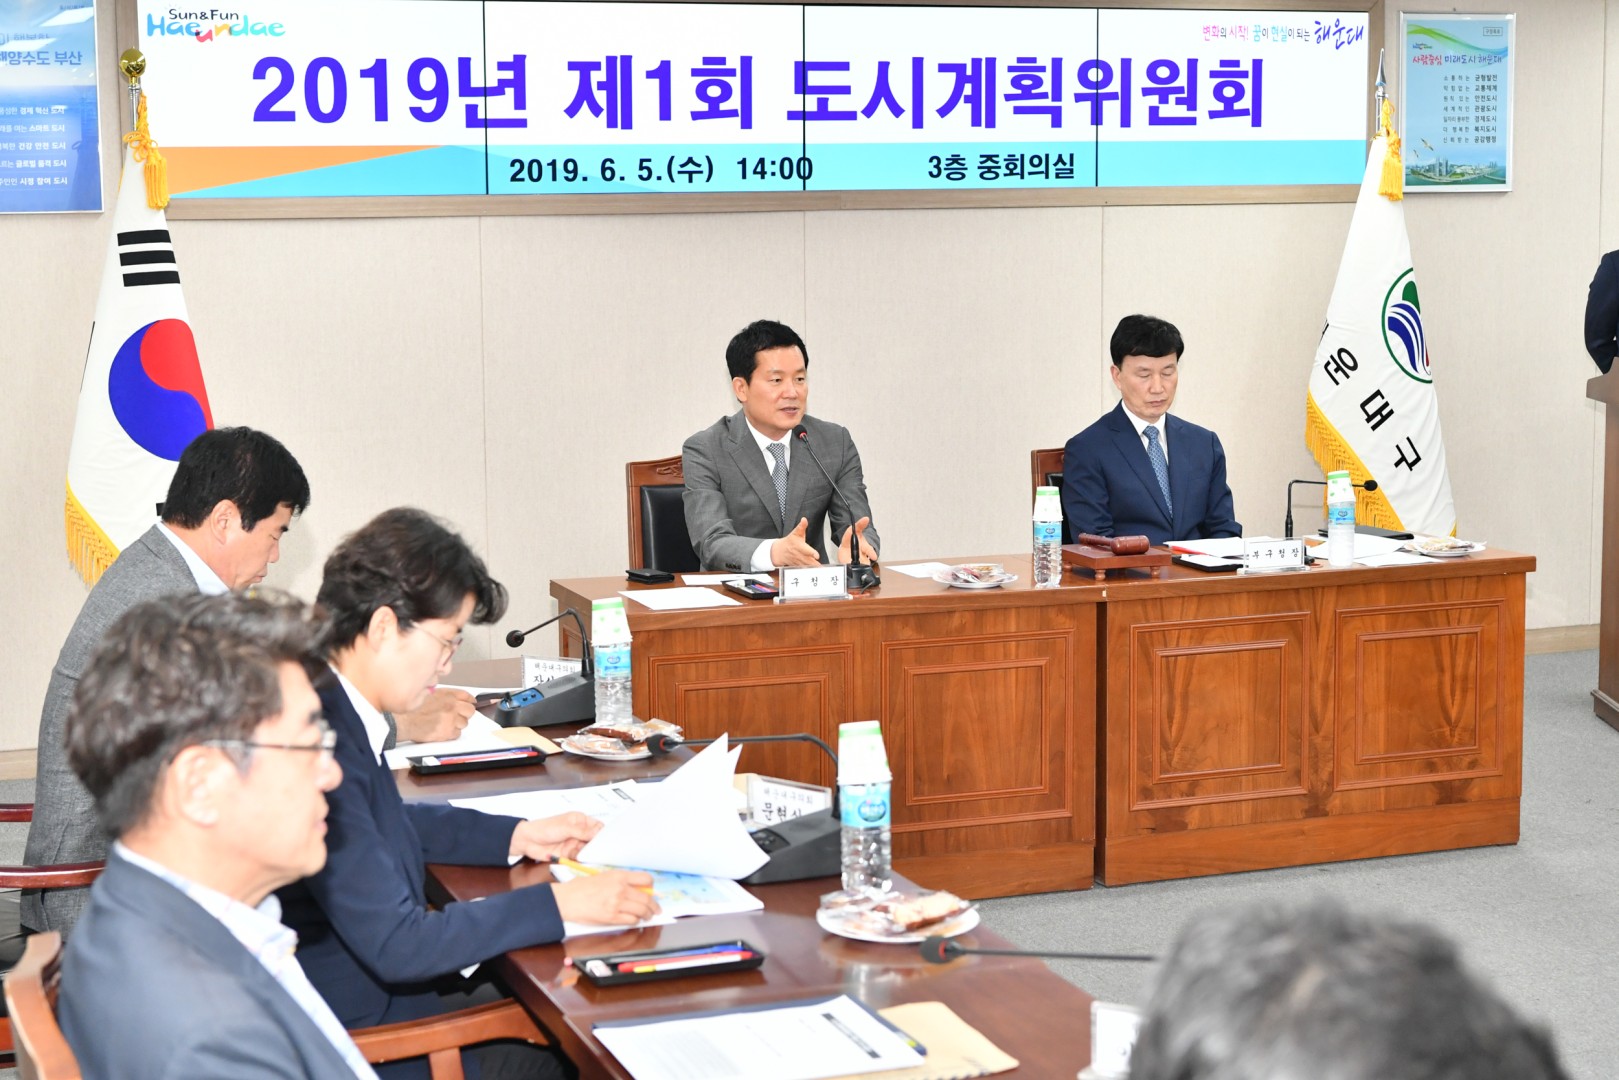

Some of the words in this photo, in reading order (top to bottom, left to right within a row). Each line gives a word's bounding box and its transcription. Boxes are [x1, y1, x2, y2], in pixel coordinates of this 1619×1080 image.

[169, 9, 239, 20] Sun&Fun
[147, 13, 286, 43] Haeundae
[1202, 24, 1227, 41] 변화의
[1229, 25, 1249, 40] 시작!
[1253, 24, 1269, 42] 꿈이
[1271, 25, 1295, 42] 현실이
[1296, 28, 1311, 42] 되는
[1314, 18, 1364, 50] 해운대
[54, 51, 83, 65] 부산
[1412, 54, 1442, 65] 사람중심
[1444, 54, 1476, 64] 미래도시
[1478, 54, 1502, 65] 해운대
[252, 54, 528, 129] 2019년
[563, 54, 753, 130] 제1회
[786, 56, 1264, 129] 도시계획위원회
[20, 107, 34, 115] 경제
[51, 107, 65, 115] 도시
[52, 142, 66, 150] 도시
[16, 160, 36, 168] 글로벌
[509, 158, 588, 183] 2019.
[600, 158, 626, 182] 6.
[737, 156, 814, 181] 14:00
[928, 155, 968, 181] 3층
[977, 153, 1076, 180] 중회의실
[20, 177, 34, 185] 시정
[37, 177, 51, 185] 참여
[53, 177, 67, 185] 도시
[1319, 322, 1422, 471] 운대구
[1252, 547, 1300, 559] 부구청장
[790, 575, 839, 588] 구청장
